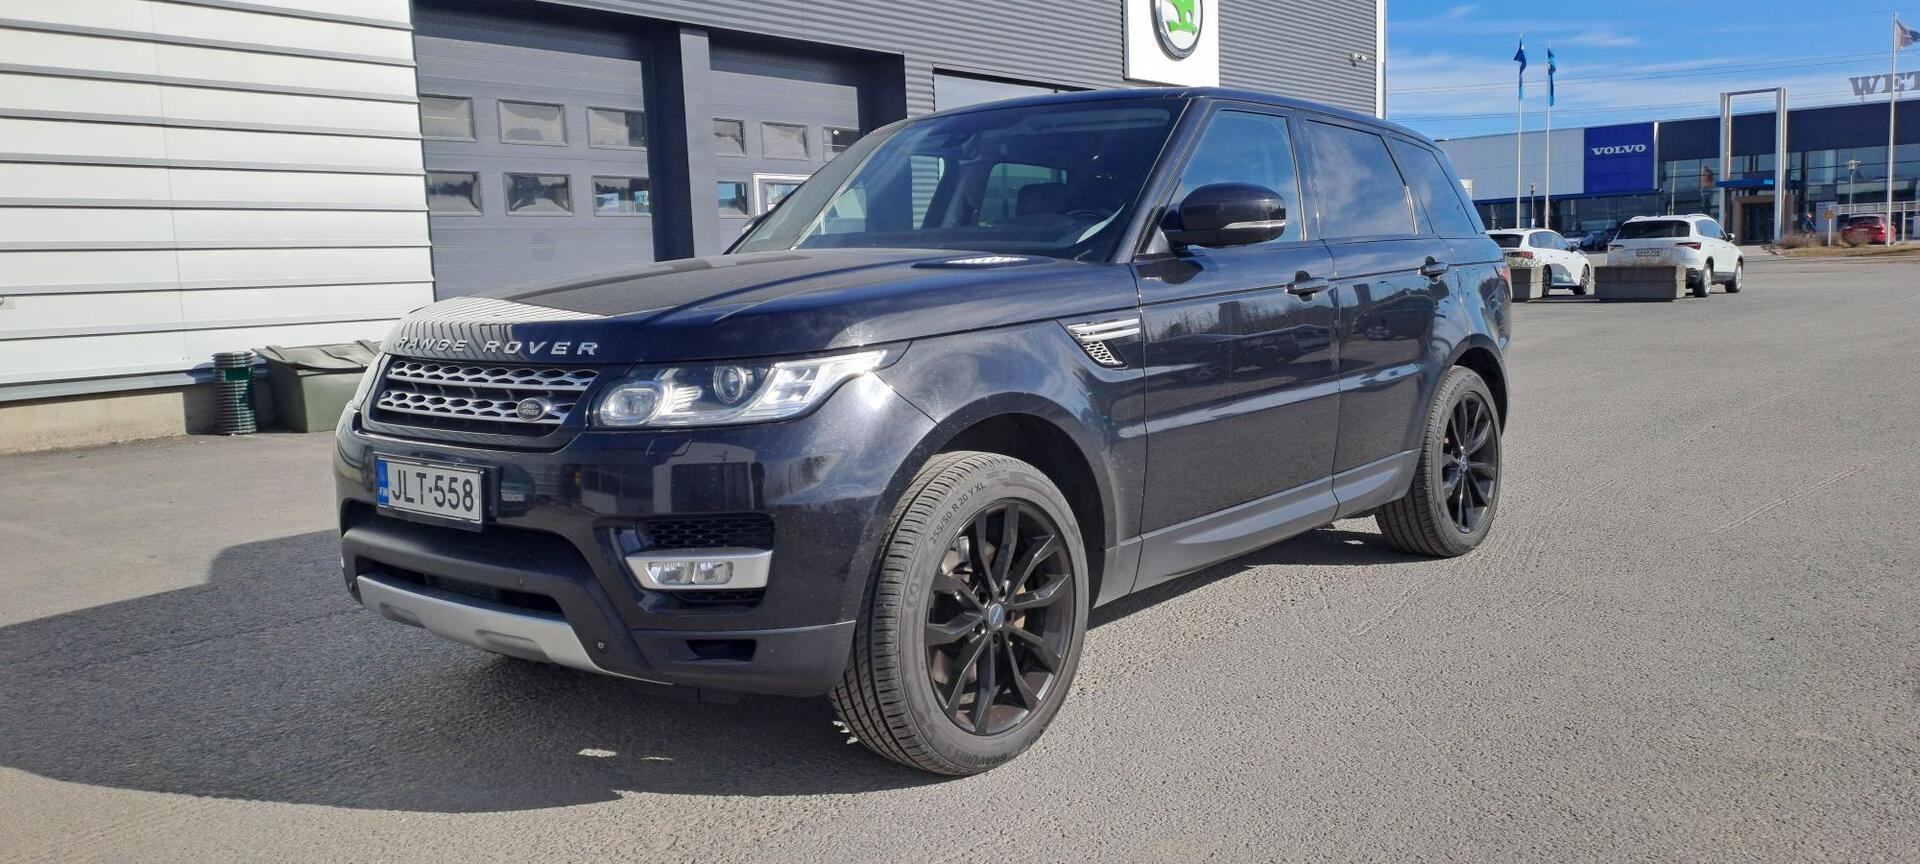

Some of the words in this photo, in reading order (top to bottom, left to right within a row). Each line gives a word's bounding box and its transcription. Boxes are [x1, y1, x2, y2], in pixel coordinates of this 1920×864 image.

[1592, 144, 1646, 155] VOLVO
[398, 336, 468, 352] RANGE
[483, 341, 599, 356] ROVER
[951, 503, 960, 512] R
[957, 494, 969, 505] 20
